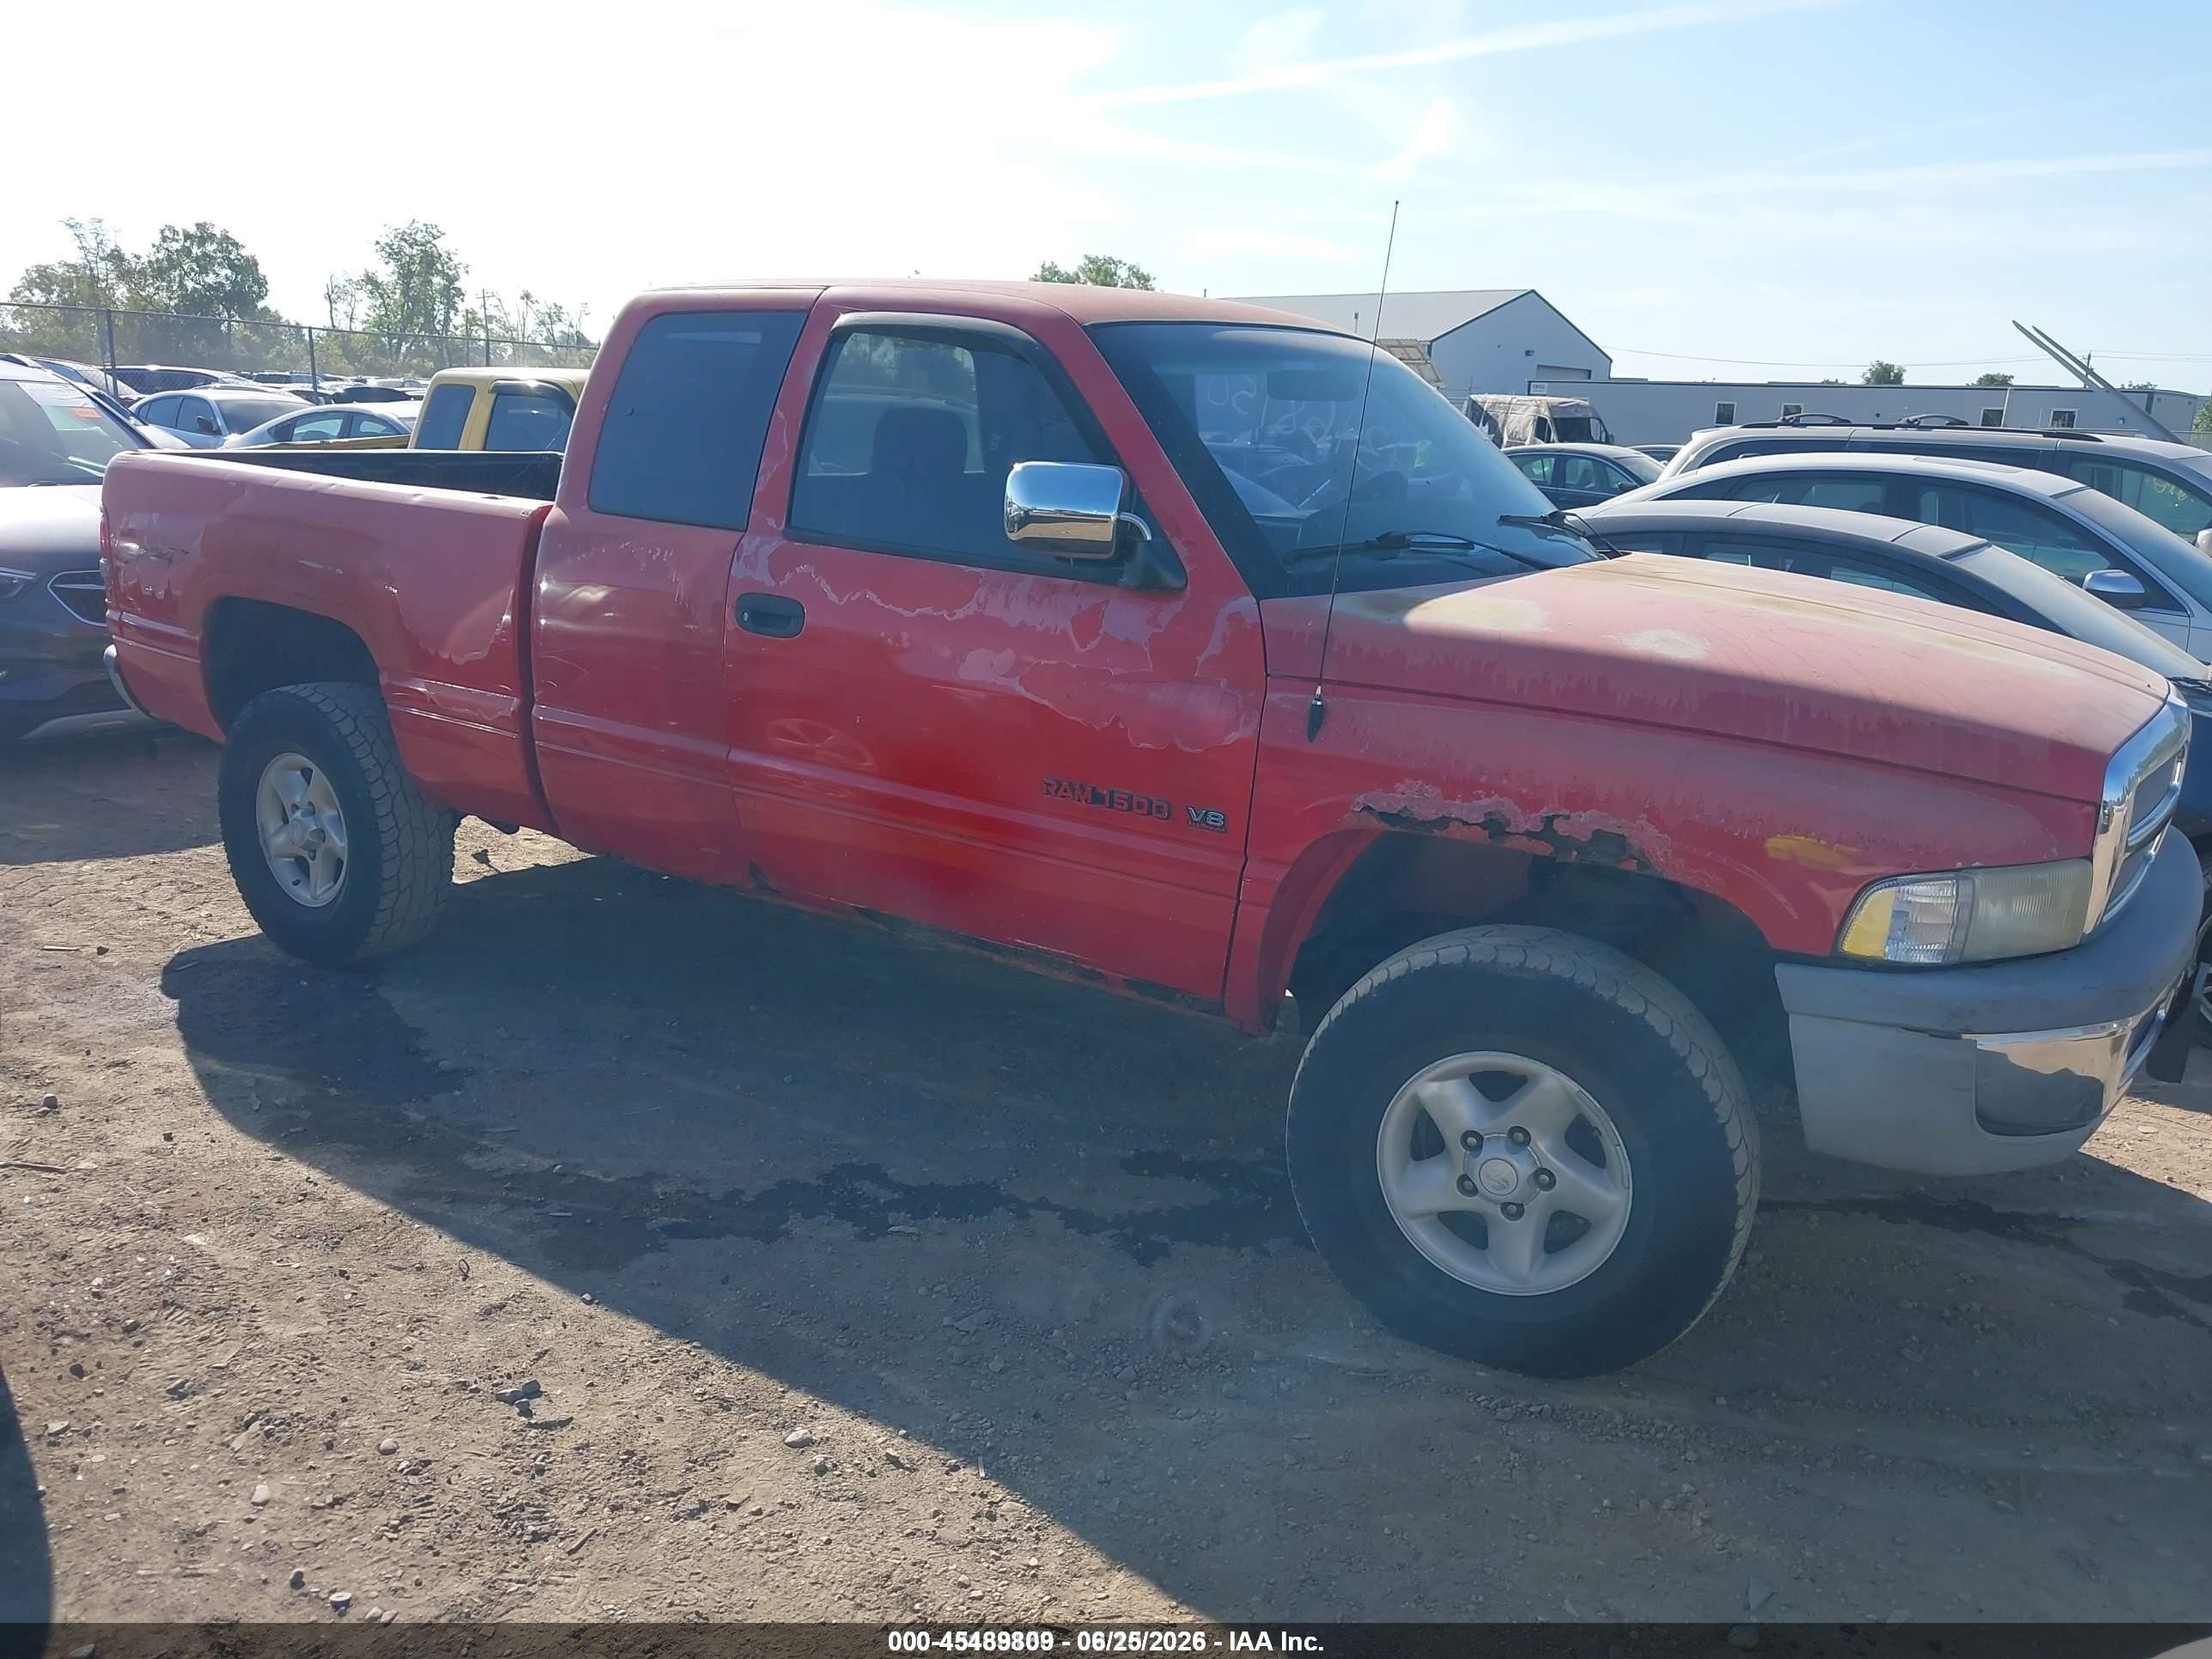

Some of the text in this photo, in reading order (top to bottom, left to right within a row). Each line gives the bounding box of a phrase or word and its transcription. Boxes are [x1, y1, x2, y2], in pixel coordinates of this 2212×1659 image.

[1043, 776, 1093, 805] RAM
[1102, 787, 1172, 820] 1500
[1187, 805, 1225, 827] V8
